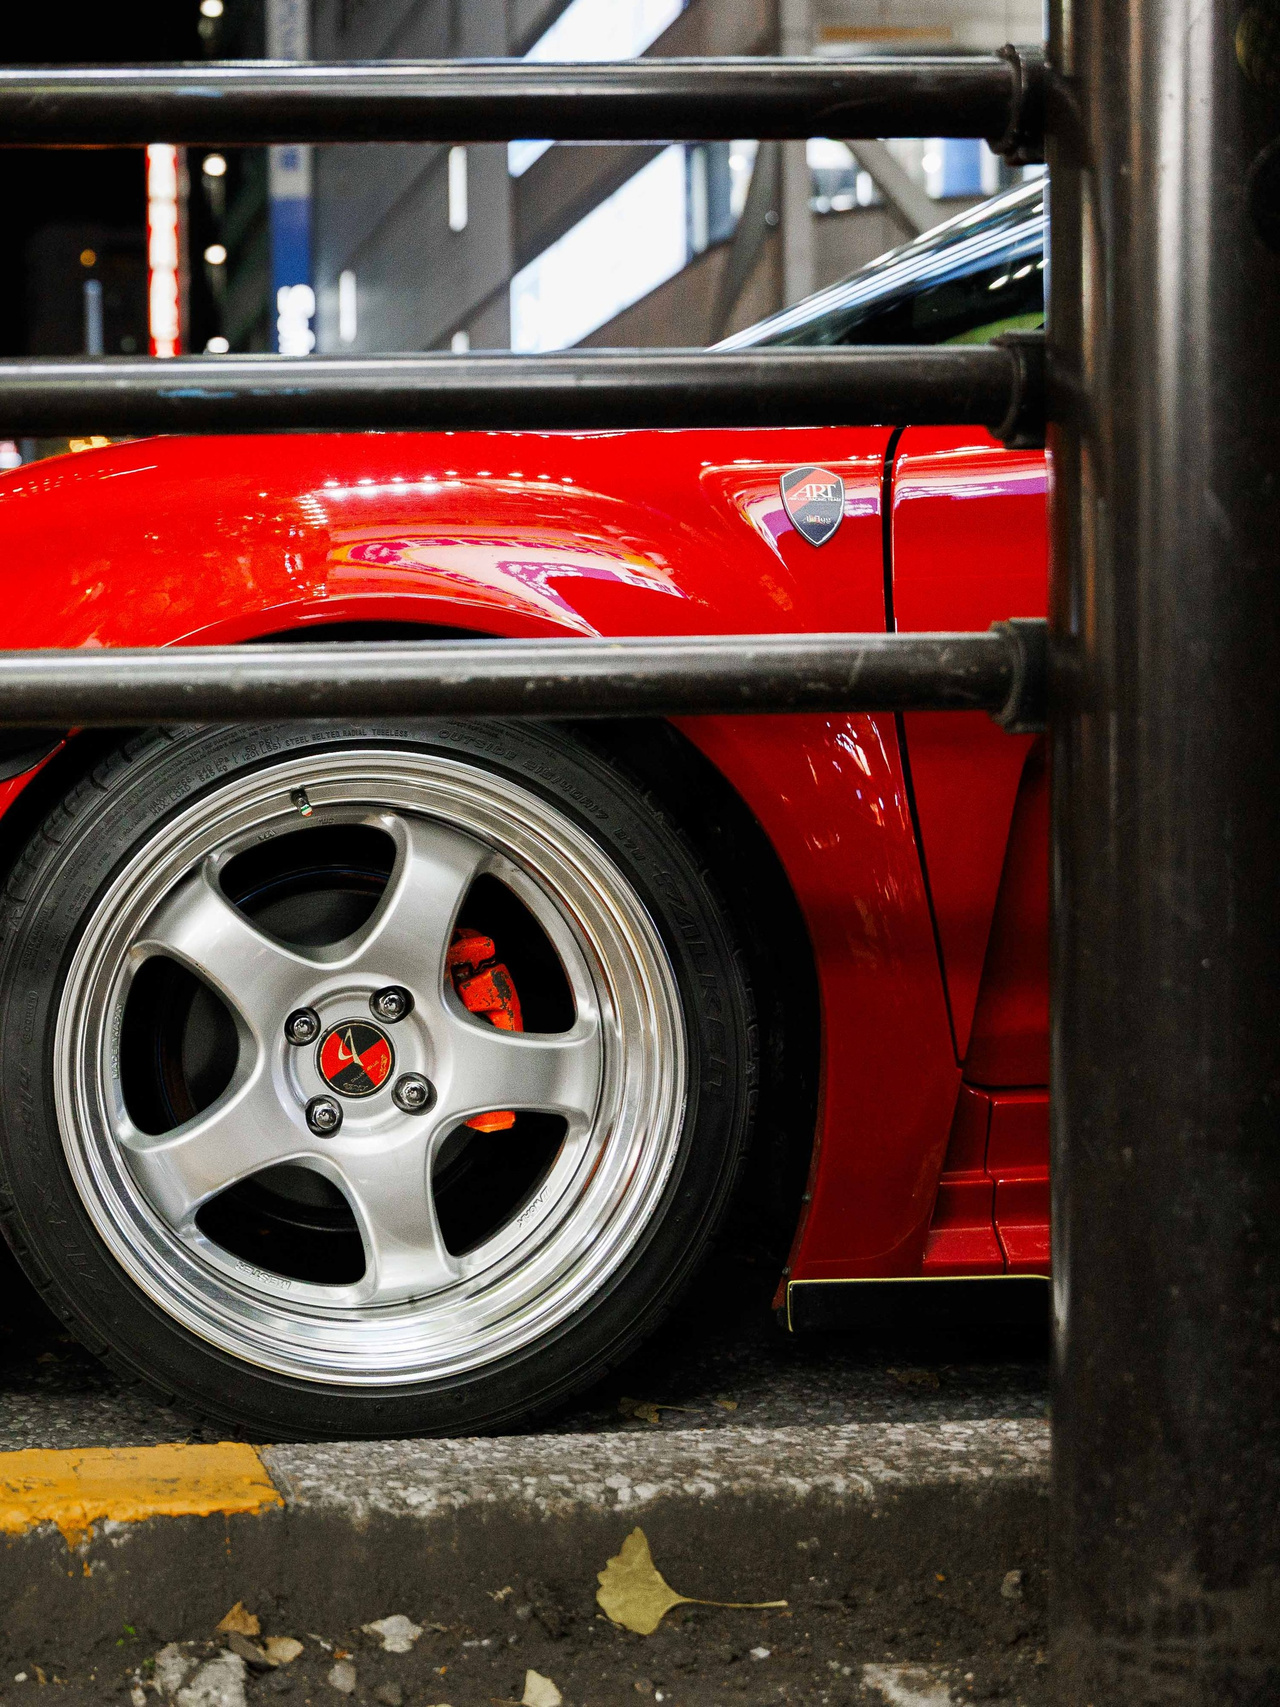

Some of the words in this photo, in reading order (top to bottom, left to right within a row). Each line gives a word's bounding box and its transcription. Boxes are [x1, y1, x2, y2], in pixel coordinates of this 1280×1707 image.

[792, 484, 836, 498] ART
[285, 735, 309, 747] STEEL
[312, 730, 340, 741] BELTED
[342, 728, 367, 737] RADIAL
[371, 728, 408, 738] TUBELESS
[437, 728, 518, 762] OUTSIDE
[166, 775, 195, 797] PRESS.
[213, 756, 230, 767] kPa
[170, 785, 192, 801] LOAD
[517, 1185, 549, 1228] WORK
[234, 1260, 292, 1290] MEISTER
